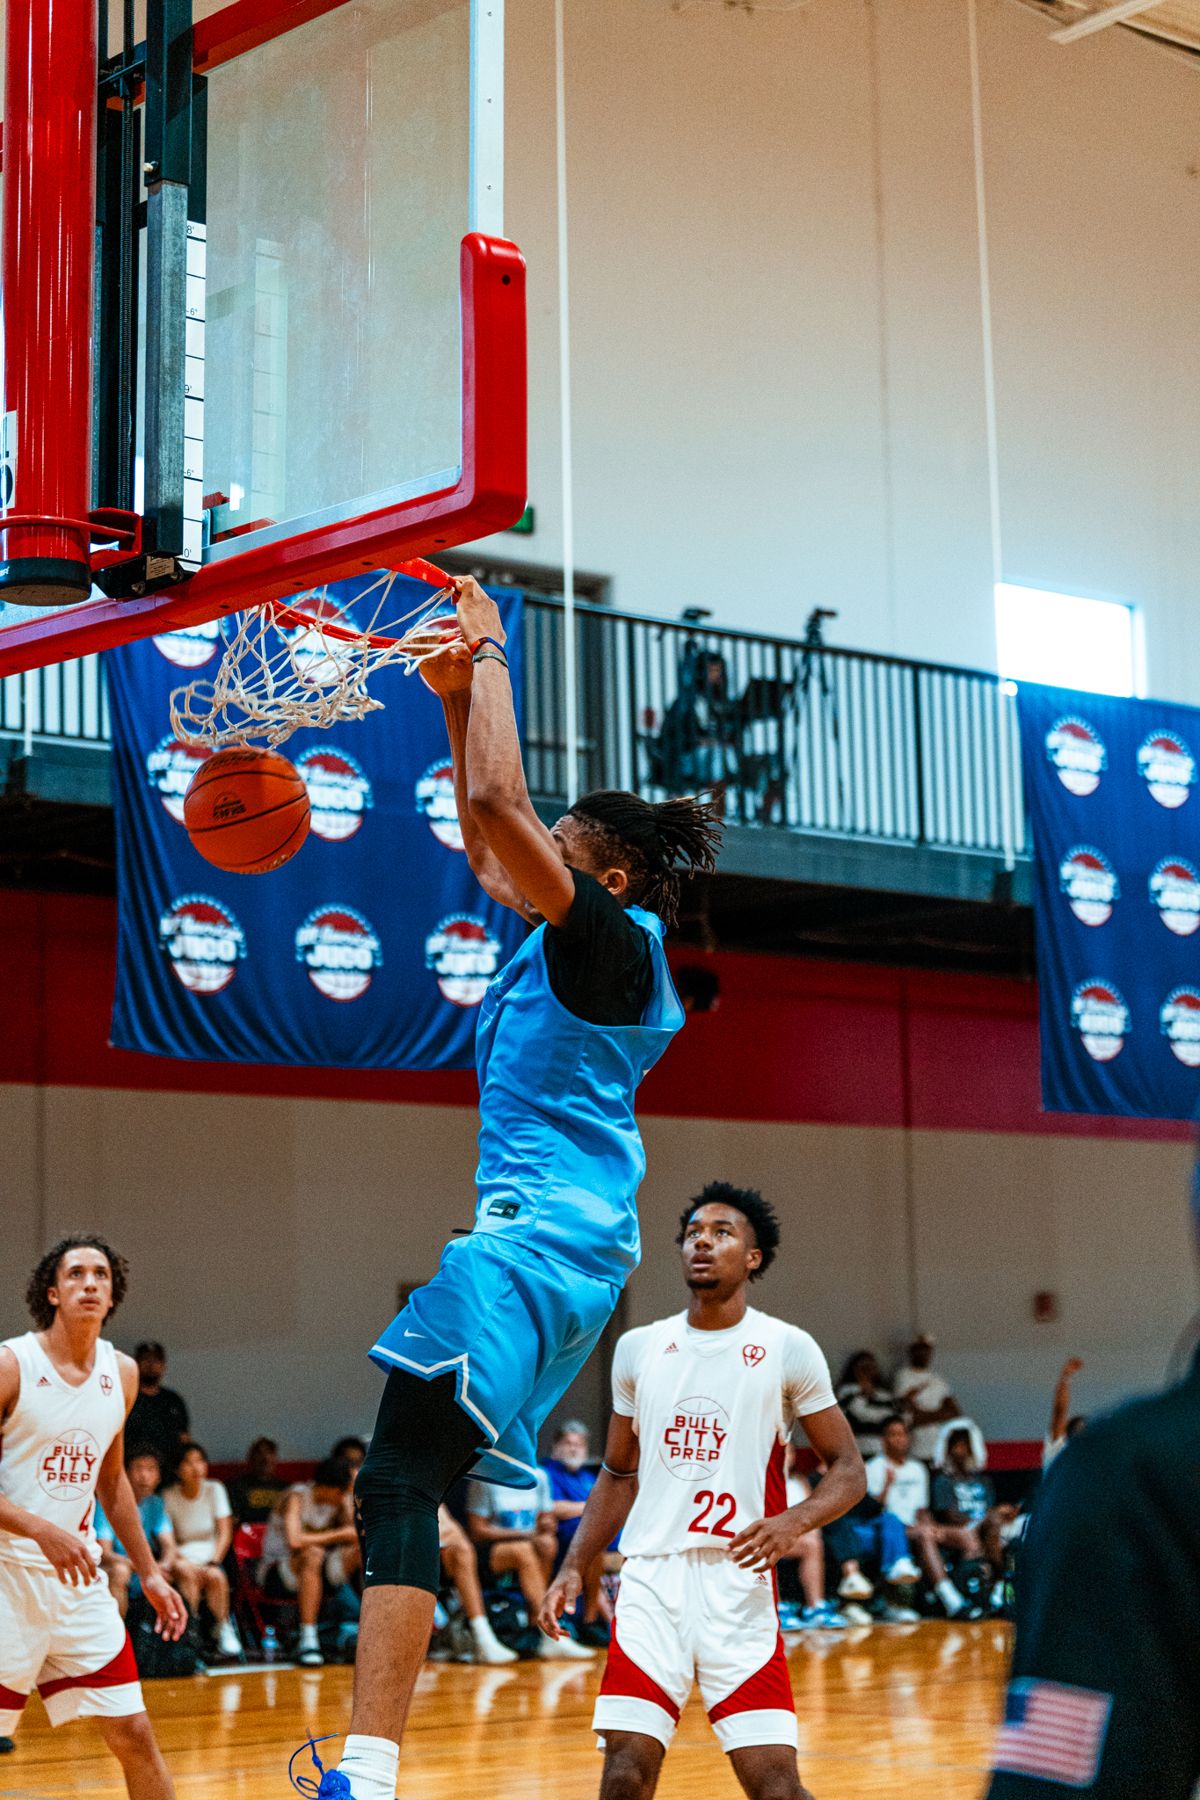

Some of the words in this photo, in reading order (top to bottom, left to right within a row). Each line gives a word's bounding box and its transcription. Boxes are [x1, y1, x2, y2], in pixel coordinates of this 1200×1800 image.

[675, 1415, 724, 1431] BULL
[664, 1428, 727, 1450] CITY
[54, 1445, 93, 1457] BULL
[670, 1447, 720, 1462] PREP
[43, 1456, 97, 1473] CITY
[47, 1472, 91, 1483] PREP
[687, 1490, 737, 1539] 22
